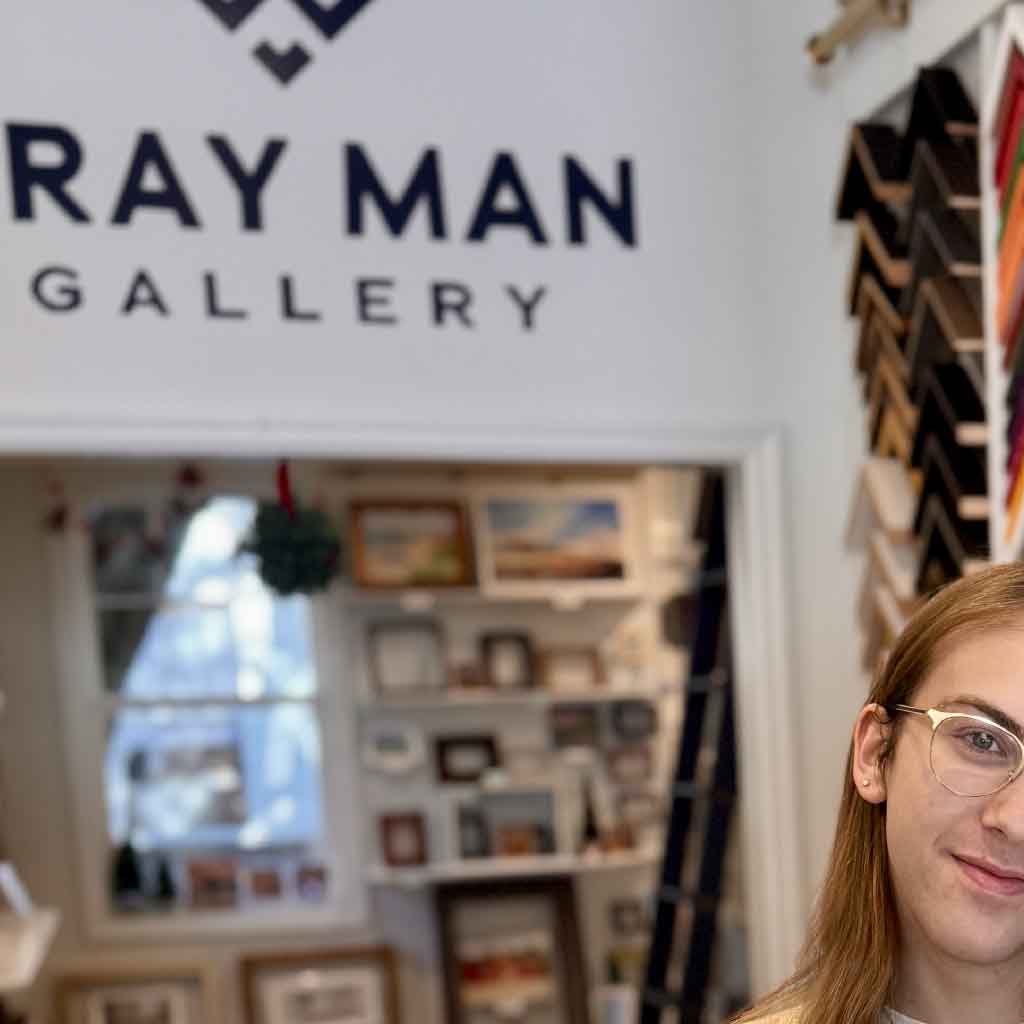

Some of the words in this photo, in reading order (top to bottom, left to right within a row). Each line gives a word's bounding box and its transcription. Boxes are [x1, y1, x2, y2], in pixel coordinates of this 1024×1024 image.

[5, 122, 287, 231] RAY
[344, 143, 637, 248] MAN
[30, 266, 546, 329] GALLERY
